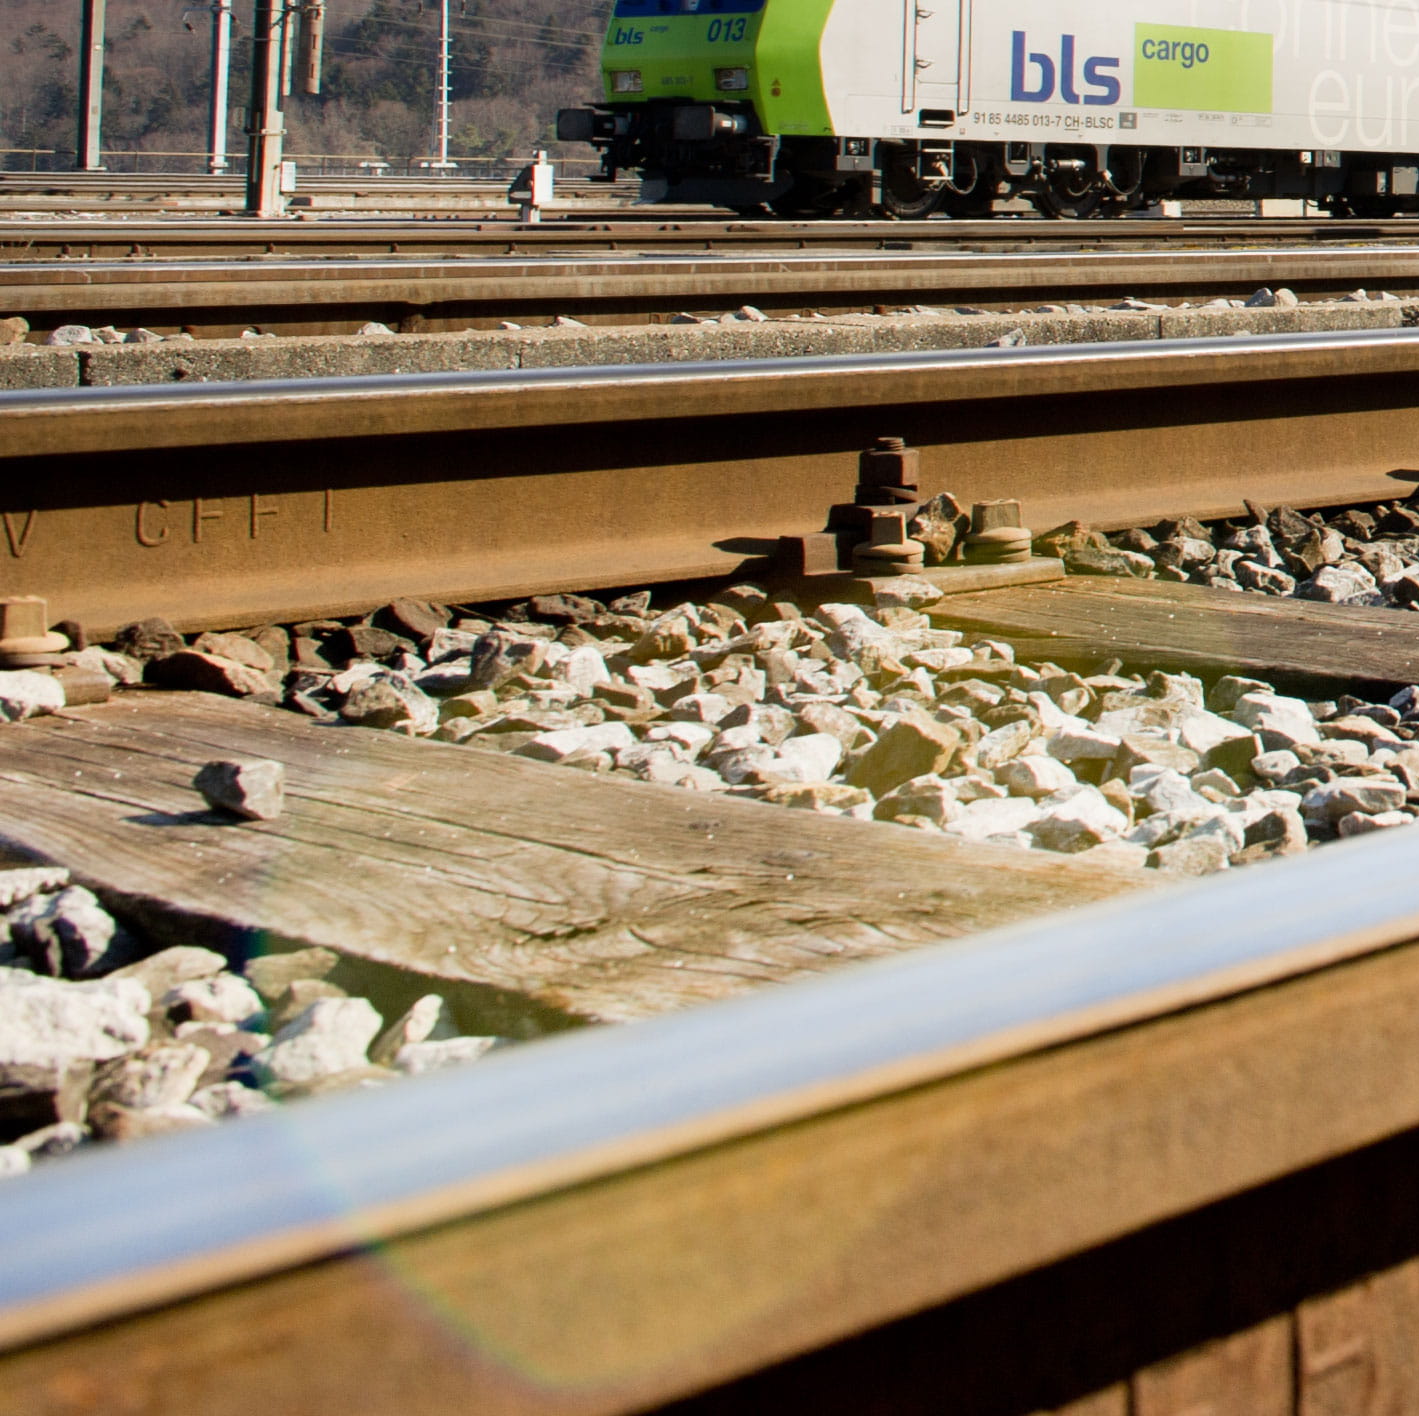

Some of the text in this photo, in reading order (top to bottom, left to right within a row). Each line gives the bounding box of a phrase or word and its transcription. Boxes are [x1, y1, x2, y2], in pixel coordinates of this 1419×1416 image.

[614, 27, 645, 45] bls
[707, 18, 747, 43] 013
[1142, 38, 1210, 69] cargo
[1010, 30, 1121, 106] bls
[973, 112, 1114, 129] 91 85 4485 013-7 CH-BLSC
